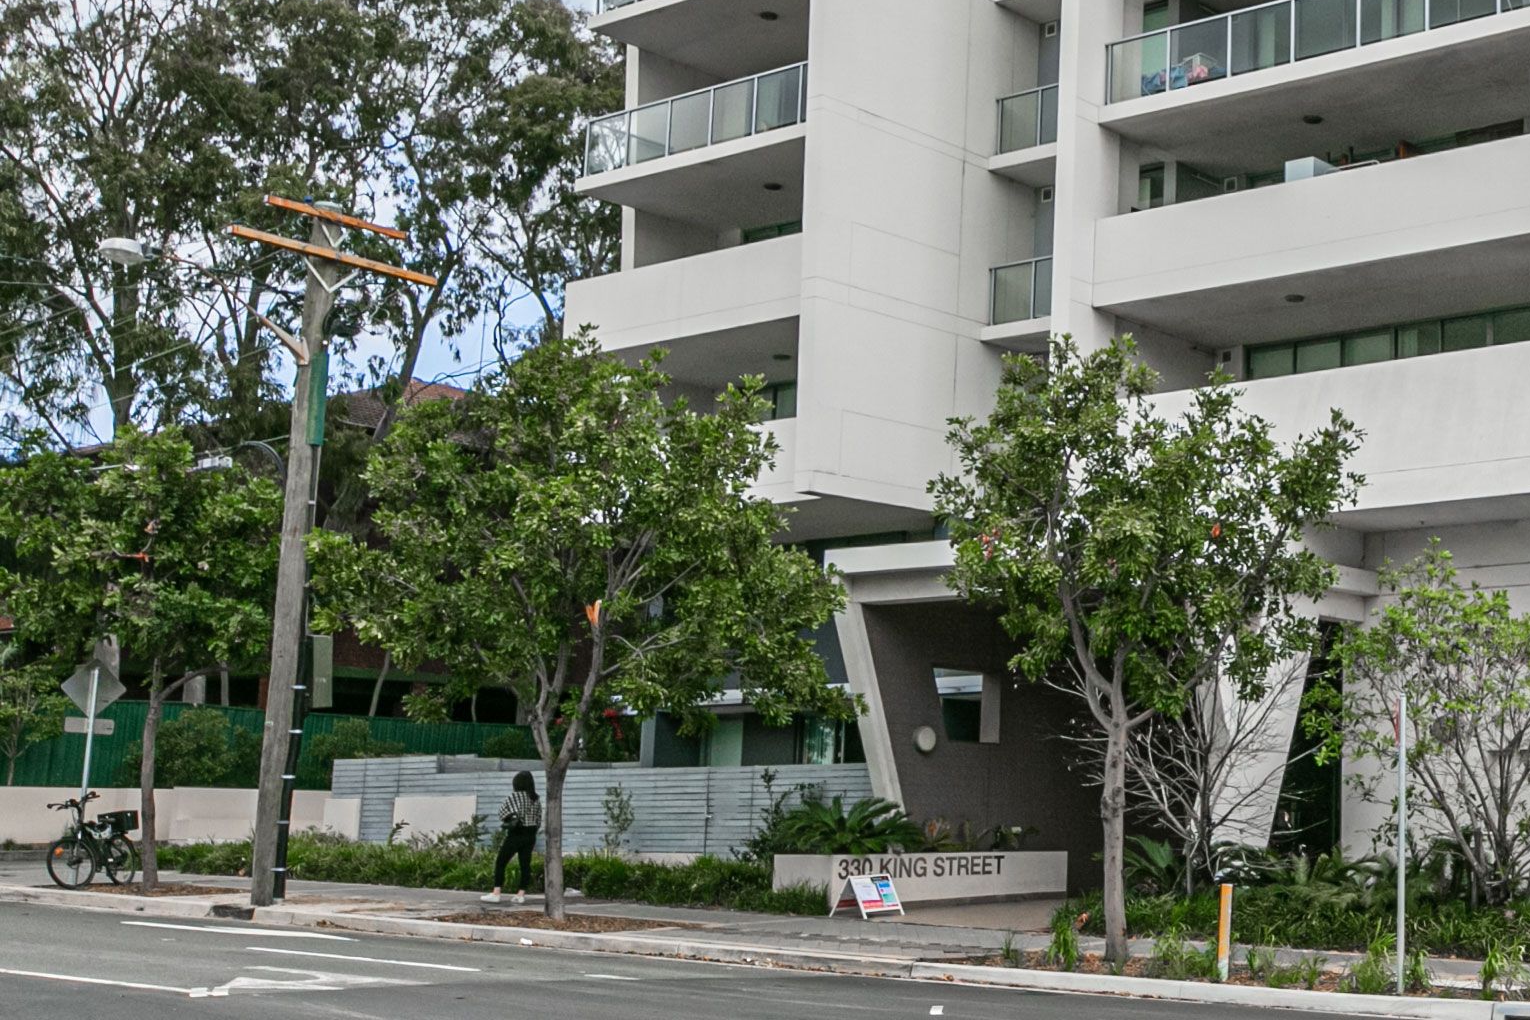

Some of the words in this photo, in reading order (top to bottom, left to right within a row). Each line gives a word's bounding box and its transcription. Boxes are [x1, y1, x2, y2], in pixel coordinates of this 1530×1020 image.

[838, 858, 872, 879] 330
[879, 857, 927, 878] KING
[933, 855, 1005, 876] STREET
